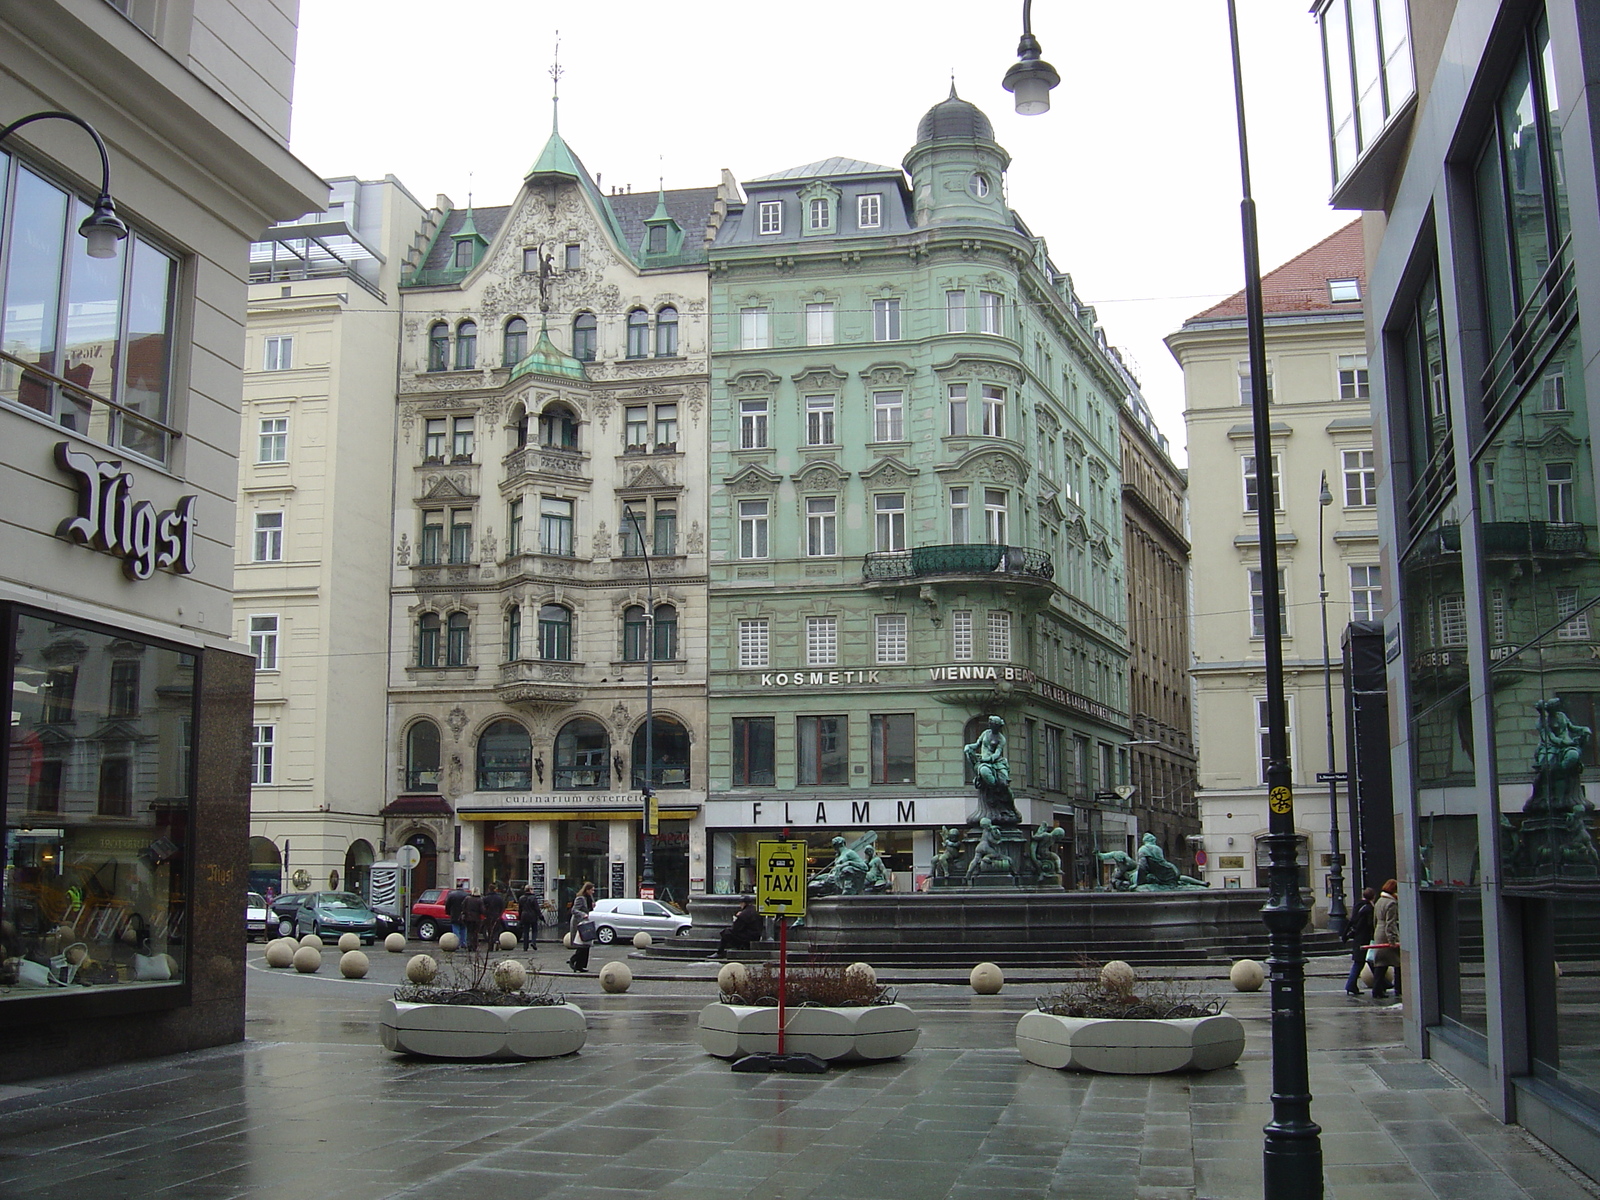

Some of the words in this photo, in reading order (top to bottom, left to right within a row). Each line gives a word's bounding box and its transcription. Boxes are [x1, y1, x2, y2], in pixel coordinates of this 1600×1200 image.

[54, 442, 197, 580] Nigst
[761, 670, 880, 687] KOSMETIK
[929, 666, 998, 680] VIENNA
[753, 801, 915, 824] FLAMM
[763, 874, 798, 892] TAXI
